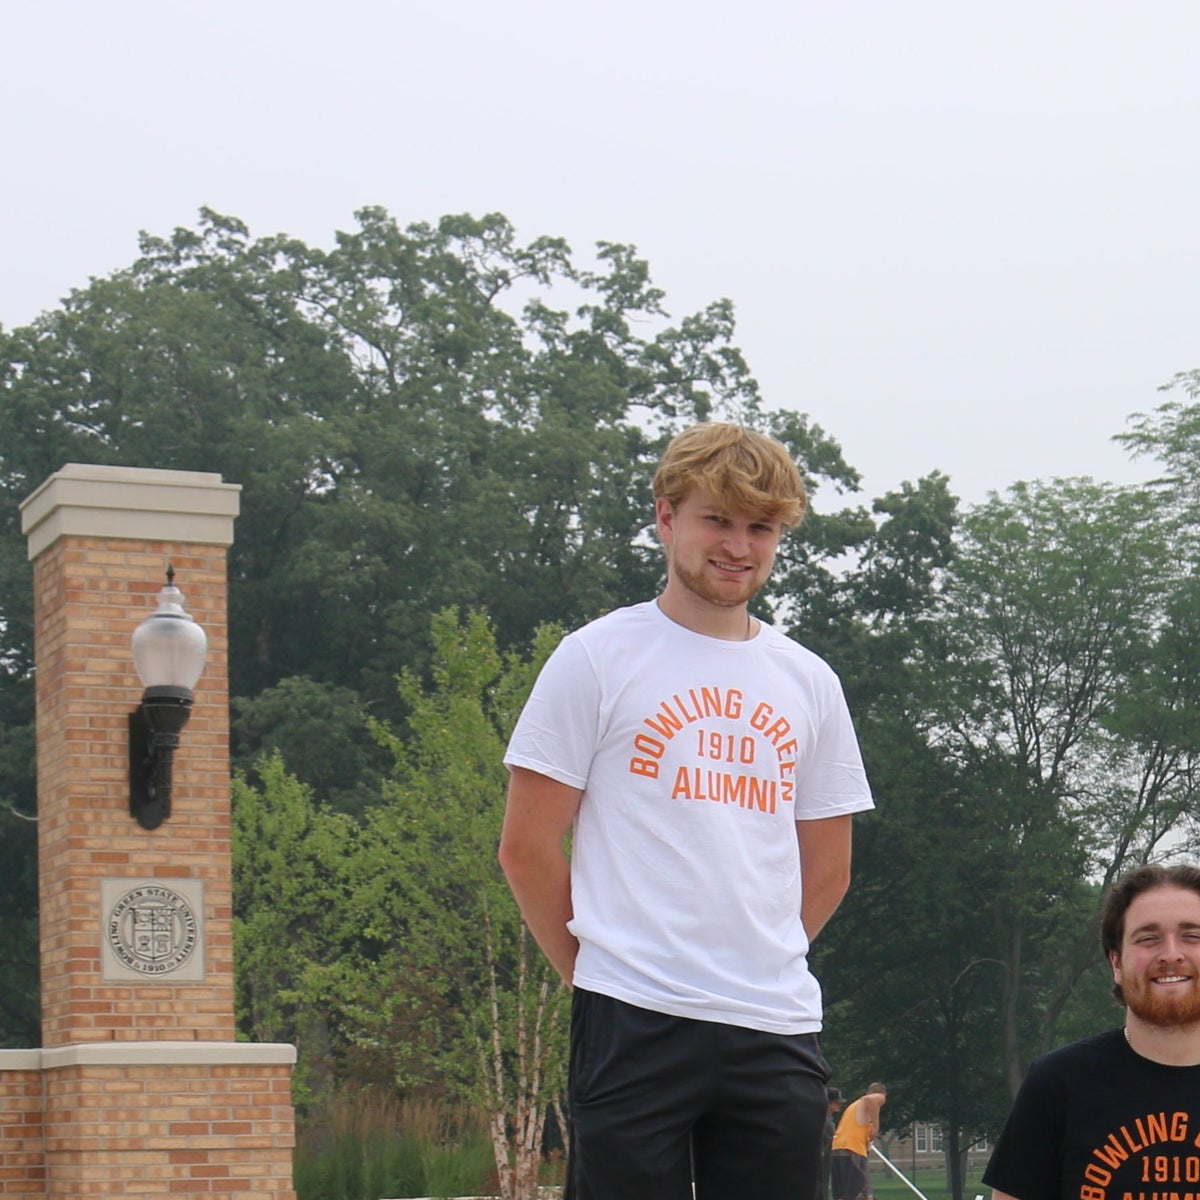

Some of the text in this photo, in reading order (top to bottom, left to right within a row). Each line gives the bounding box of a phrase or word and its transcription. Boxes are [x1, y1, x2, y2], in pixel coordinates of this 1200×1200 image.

[630, 686, 798, 801] BOWLING GREEN
[697, 729, 756, 764] 1910
[671, 765, 777, 814] ALUMNI
[111, 889, 194, 964] BOWLING GREEN STATE UNIVERSITY
[142, 963, 166, 972] 1910
[1141, 1156, 1200, 1183] 1910
